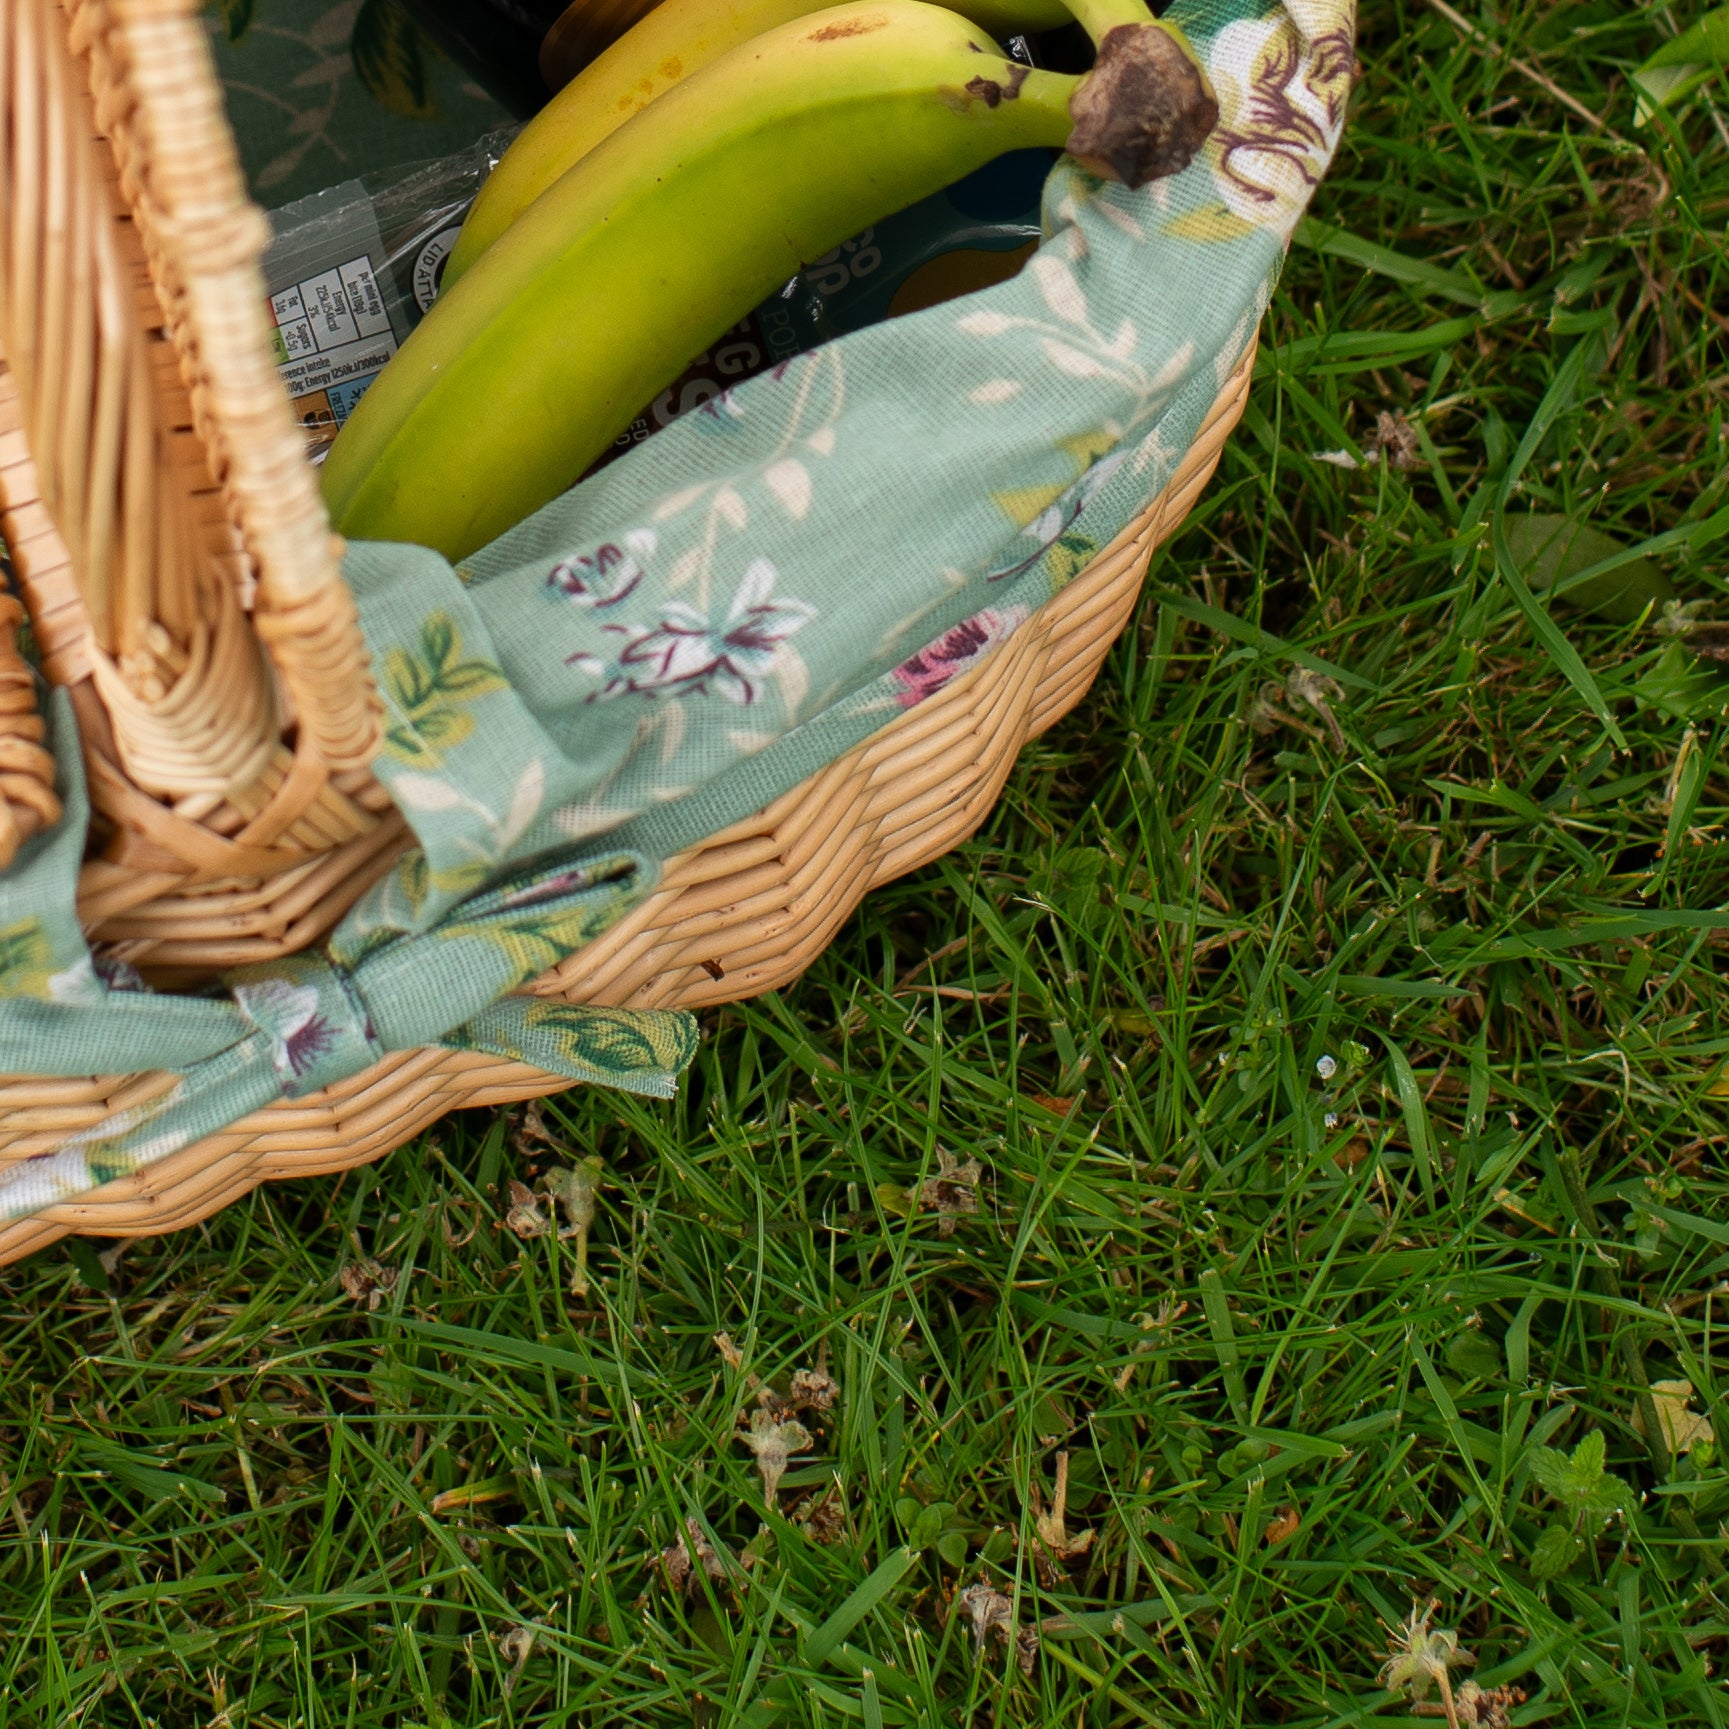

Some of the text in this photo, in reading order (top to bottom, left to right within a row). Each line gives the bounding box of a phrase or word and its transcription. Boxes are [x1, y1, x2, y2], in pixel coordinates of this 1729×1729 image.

[422, 242, 444, 266] LID
[364, 284, 379, 301] mini
[332, 290, 347, 315] Energy
[369, 300, 383, 316] egg
[307, 304, 320, 319] 3%
[296, 323, 312, 350] Sugars
[306, 358, 331, 373] intake
[305, 372, 331, 389] Energy
